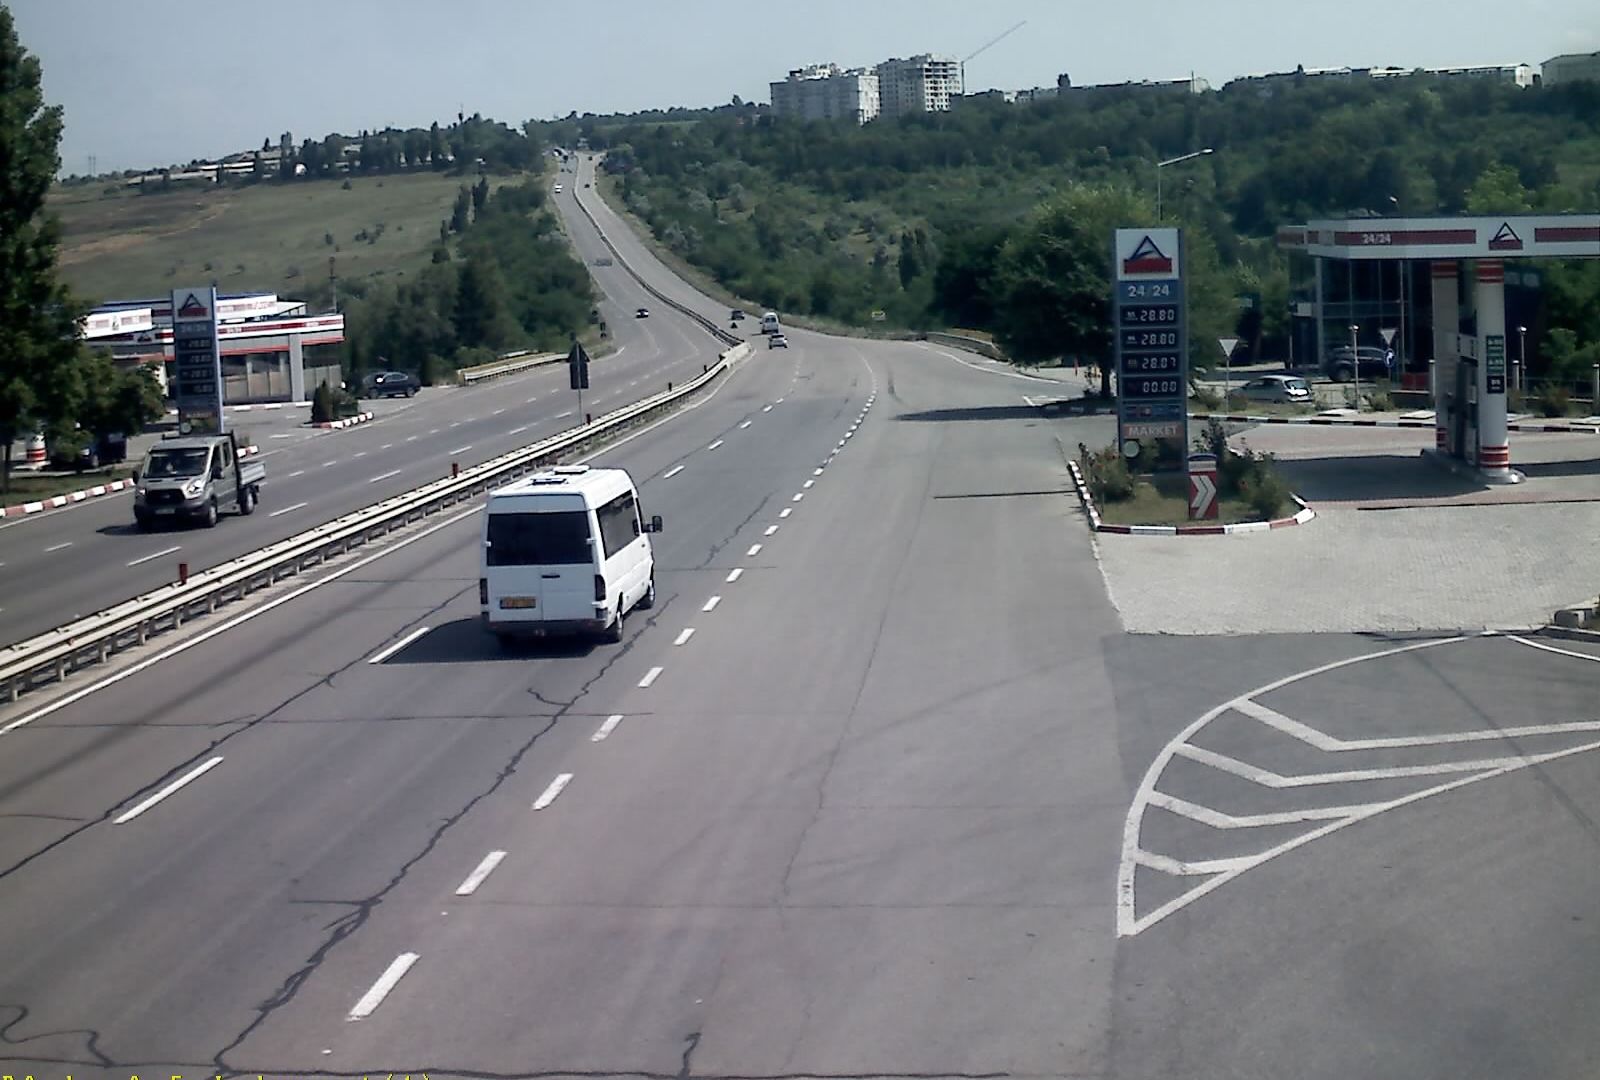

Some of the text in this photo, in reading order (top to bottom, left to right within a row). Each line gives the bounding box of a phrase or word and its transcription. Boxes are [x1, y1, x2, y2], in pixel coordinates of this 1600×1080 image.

[1362, 233, 1391, 244] 24/24
[1140, 309, 1175, 321] 28.80
[1141, 333, 1176, 345] 28.80
[1142, 357, 1177, 369] 28.07
[1143, 381, 1177, 393] 00.00
[1128, 425, 1177, 436] MARKET
